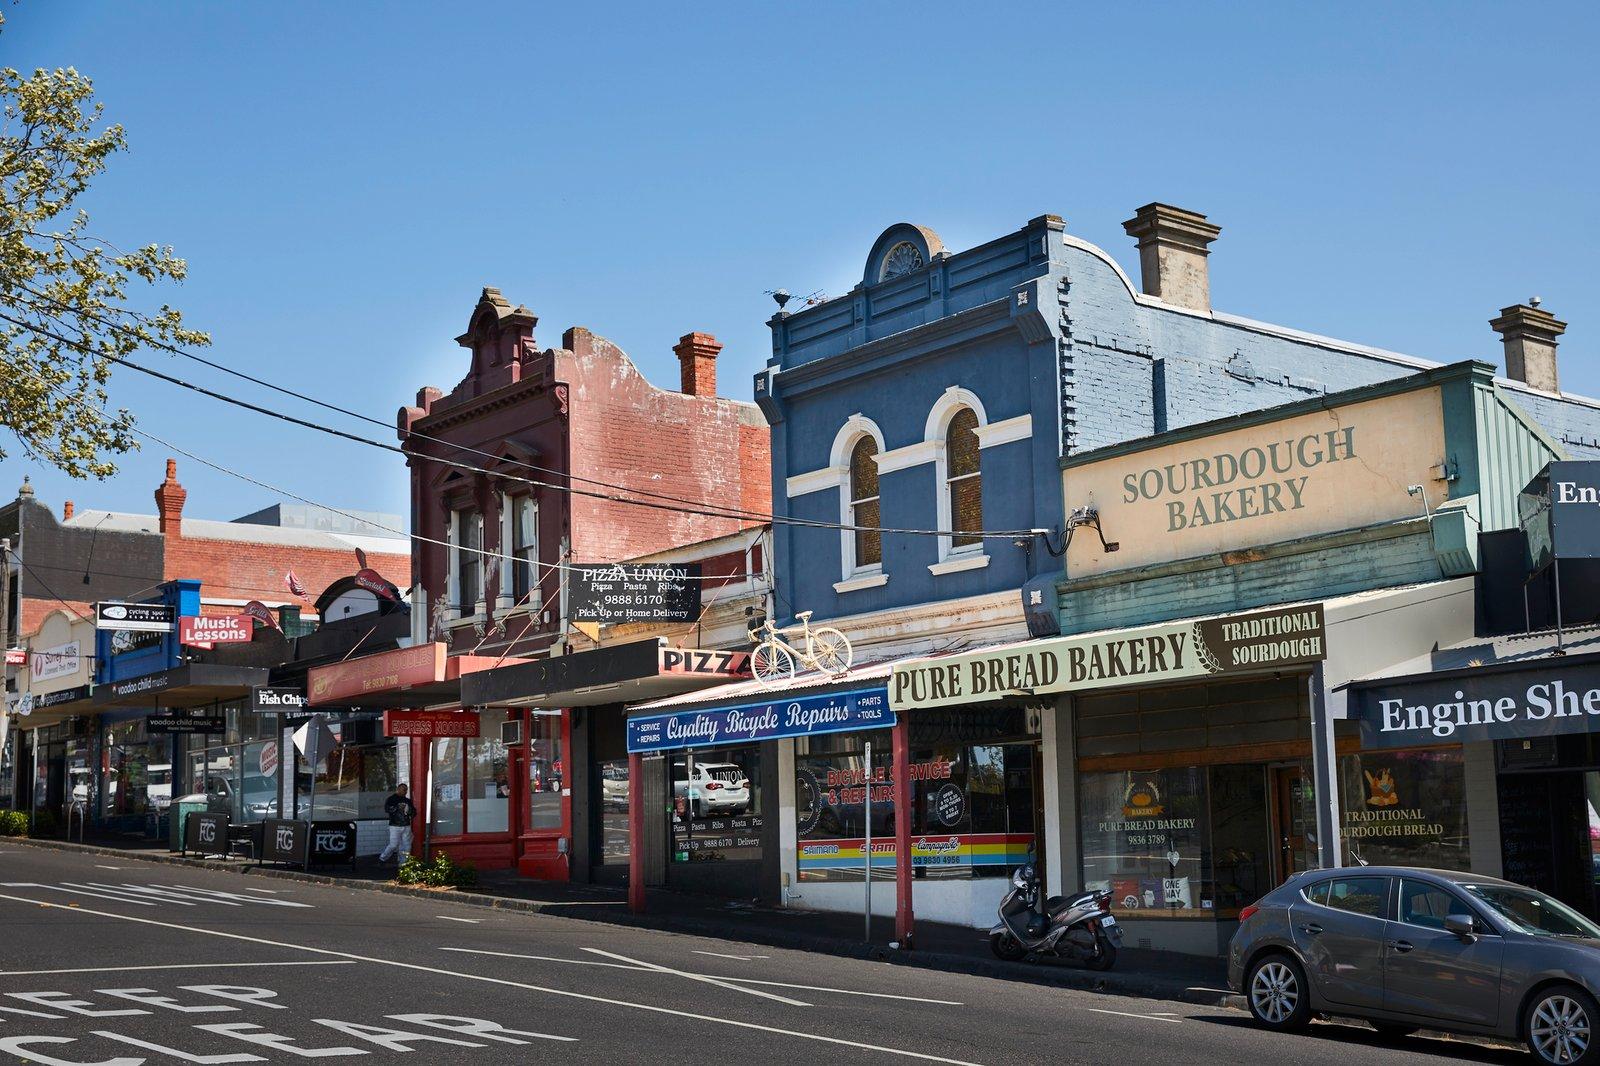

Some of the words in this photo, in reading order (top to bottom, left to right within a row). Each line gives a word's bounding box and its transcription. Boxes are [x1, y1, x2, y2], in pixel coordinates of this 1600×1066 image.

[1123, 426, 1357, 504] SOURDOUGH
[1166, 476, 1309, 532] BAKERY
[582, 568, 628, 581] PIZZA
[633, 568, 688, 581] UNION
[591, 582, 613, 591] Pizza
[624, 582, 647, 590] Pasta
[659, 582, 678, 590] Ribs
[605, 595, 632, 605] 9888
[635, 595, 663, 605] 6170
[579, 609, 596, 617] Pick
[626, 609, 651, 617] Home
[653, 609, 689, 618] Delivery
[194, 616, 239, 630] Music
[1221, 611, 1321, 642] TRADITIONAL
[185, 629, 247, 641] Lessons
[1232, 638, 1322, 666] SOURDOUGH
[894, 664, 962, 704] PURE
[970, 651, 1059, 694] BREAD
[1068, 632, 1187, 683] BAKERY
[118, 682, 137, 695] voodoo
[259, 694, 281, 704] Fish
[282, 694, 308, 707] Chips
[862, 696, 882, 706] PARTS
[862, 709, 882, 720] TOOLS
[1378, 691, 1516, 737] Engine
[392, 720, 432, 734] EXPRESS
[435, 721, 476, 735] NOODLES
[641, 722, 660, 731] SERVICE
[667, 715, 719, 742] Quality
[725, 706, 778, 738] Bicycle
[785, 701, 849, 731] Repairs
[641, 734, 660, 743] REPAIRS
[828, 789, 838, 806] &
[1344, 809, 1425, 821] TRADITIONAL
[712, 821, 724, 829] Ribs
[1099, 822, 1122, 832] PURE
[1124, 820, 1155, 831] BREAD
[1157, 818, 1195, 830] BAKERY
[1404, 824, 1443, 836] BREAD
[679, 842, 690, 850] Pick
[691, 841, 699, 850] Up
[718, 839, 732, 847] 6170
[737, 838, 759, 847] Delivery
[1128, 835, 1146, 845] 9836
[1147, 834, 1166, 844] 3789
[803, 845, 839, 854] SHIMANO
[911, 837, 961, 855] Campagnolo
[913, 856, 922, 864] 03
[1165, 881, 1180, 889] ONE
[1165, 889, 1181, 898] WAY
[0, 1013, 579, 1066] CLEAR
